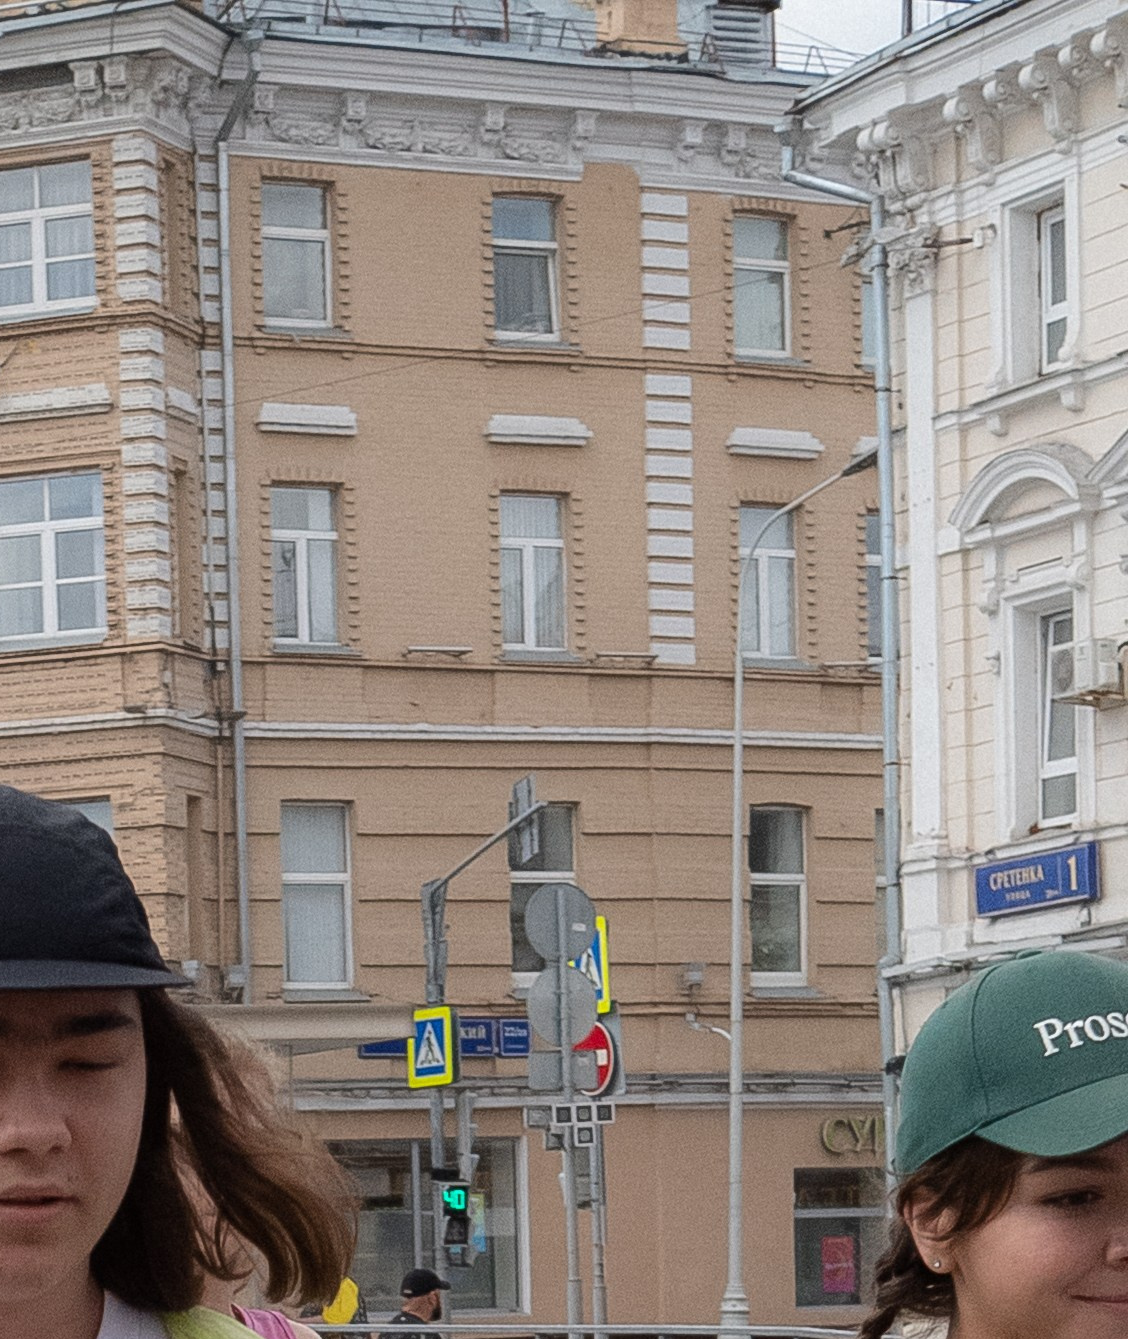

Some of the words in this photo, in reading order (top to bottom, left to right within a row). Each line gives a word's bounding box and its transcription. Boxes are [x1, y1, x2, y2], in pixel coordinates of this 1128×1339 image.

[989, 864, 1045, 892] СРЕТЕНКА
[1067, 854, 1078, 891] 1
[1032, 1011, 1128, 1057] Pros
[443, 1189, 466, 1210] 40
